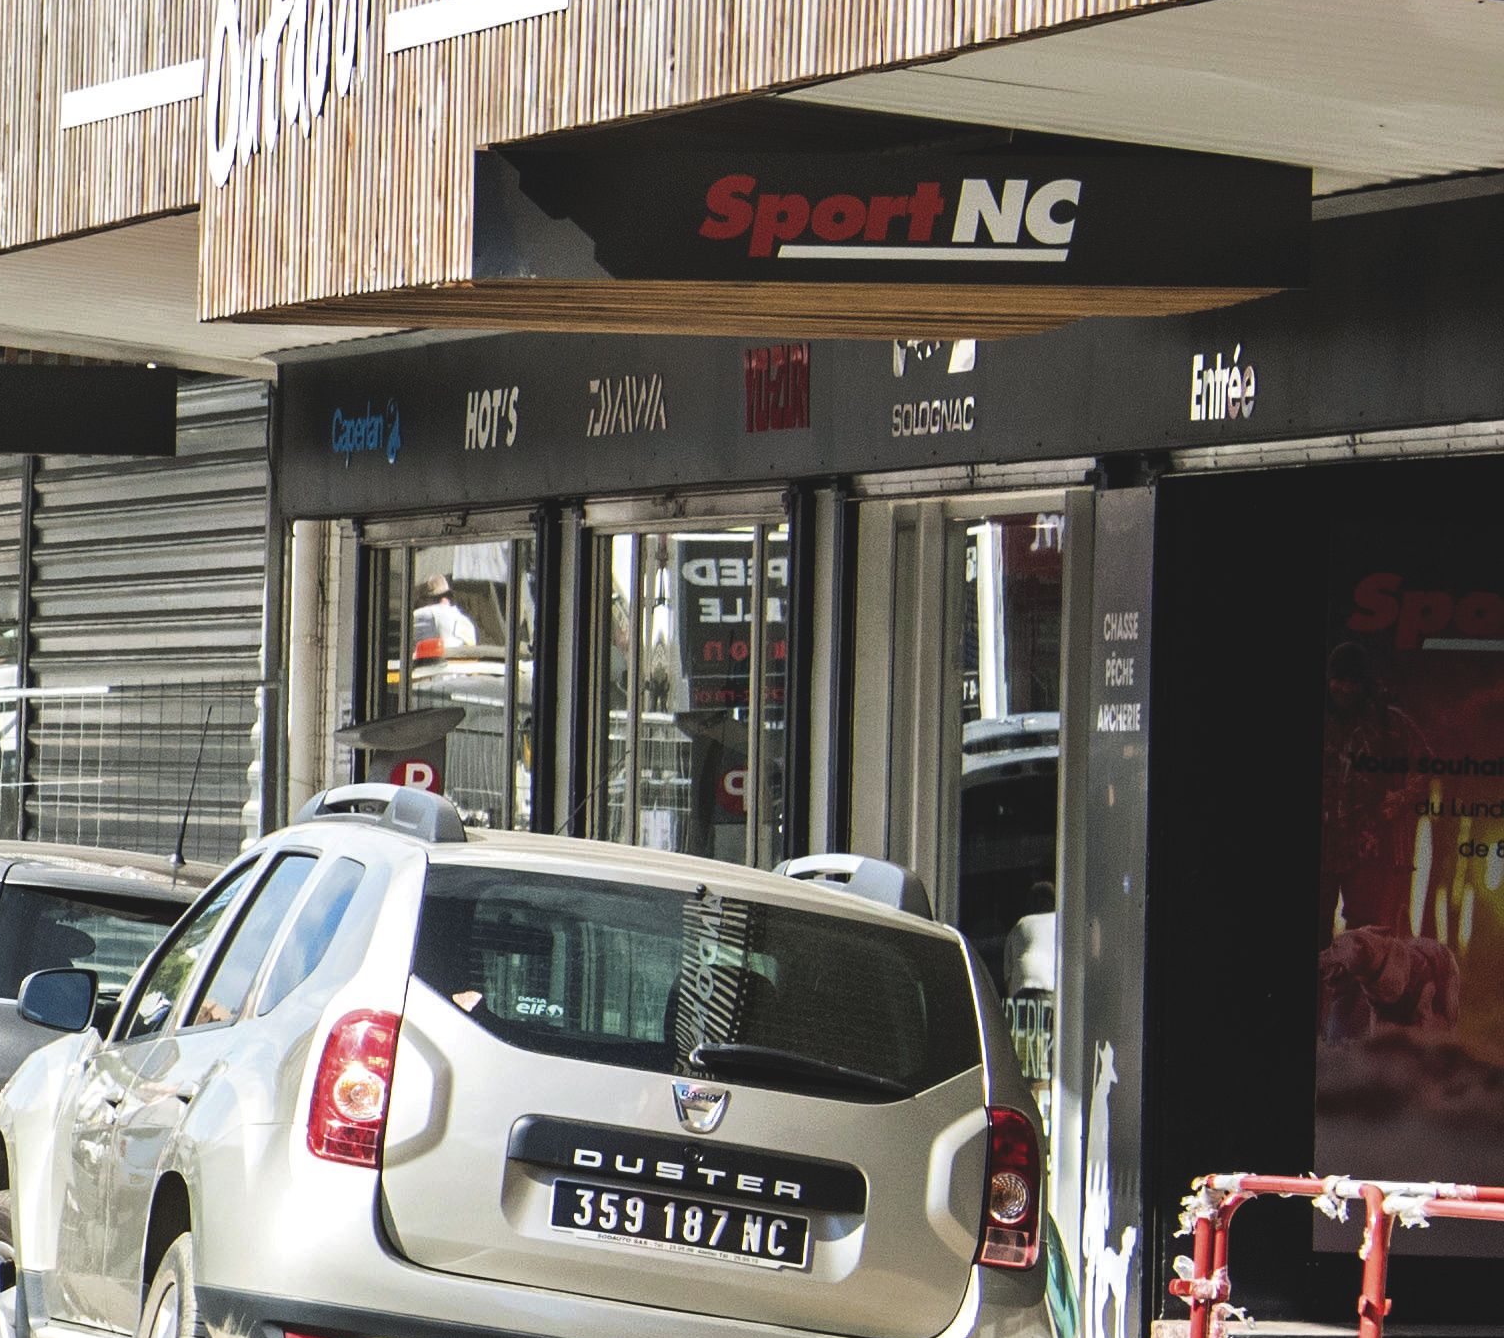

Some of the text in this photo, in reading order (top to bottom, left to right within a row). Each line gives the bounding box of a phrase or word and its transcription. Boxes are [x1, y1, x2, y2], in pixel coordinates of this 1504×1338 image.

[699, 174, 1082, 256] Sport NC
[1191, 343, 1255, 421] Entrée
[332, 400, 384, 468] Caperlan
[892, 396, 975, 437] SOLOGNAC
[1103, 612, 1139, 641] CHASSE
[1097, 703, 1142, 732] ARCHERIE
[1352, 755, 1408, 774] Vous
[1415, 798, 1444, 818] du
[1460, 839, 1489, 858] de
[516, 1002, 547, 1016] elf
[573, 1148, 802, 1199] DUSTER
[573, 1188, 645, 1234] 359
[664, 1202, 729, 1246] 187
[742, 1213, 788, 1257] NC
